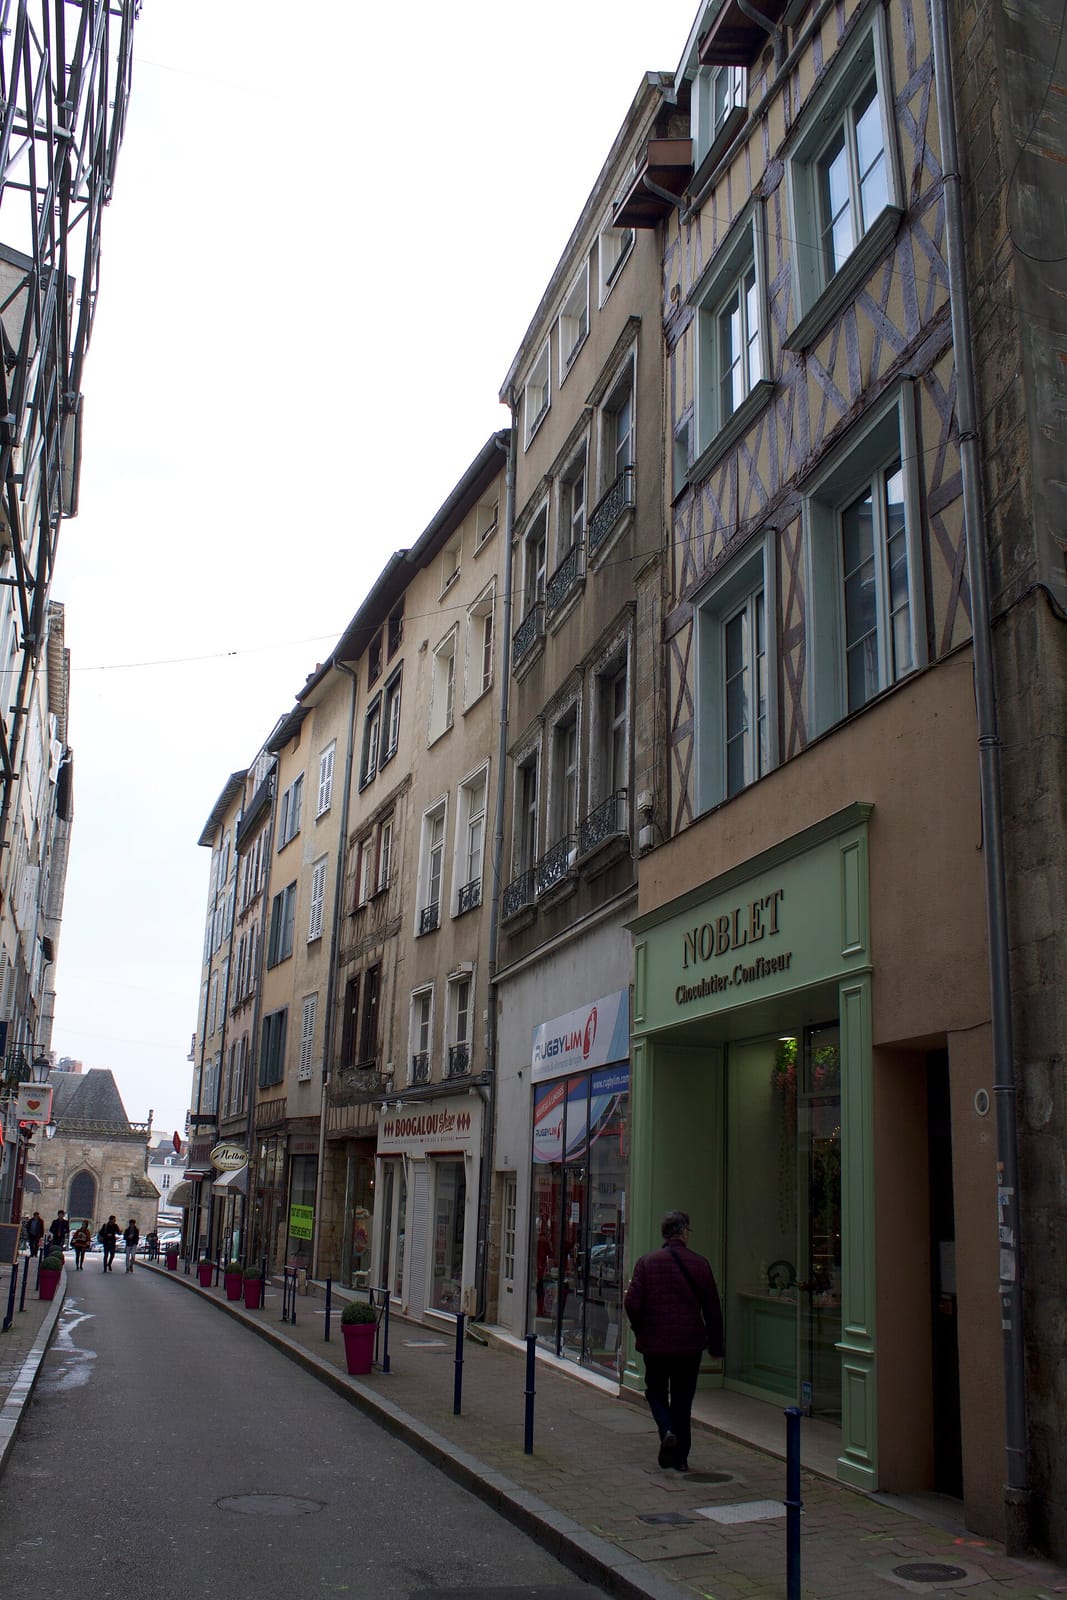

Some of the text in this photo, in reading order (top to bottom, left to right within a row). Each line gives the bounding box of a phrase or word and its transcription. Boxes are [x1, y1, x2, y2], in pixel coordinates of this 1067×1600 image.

[682, 889, 784, 969] NOBLET
[534, 1029, 582, 1062] RUGBYLIM
[395, 1113, 439, 1137] BOOGALOU
